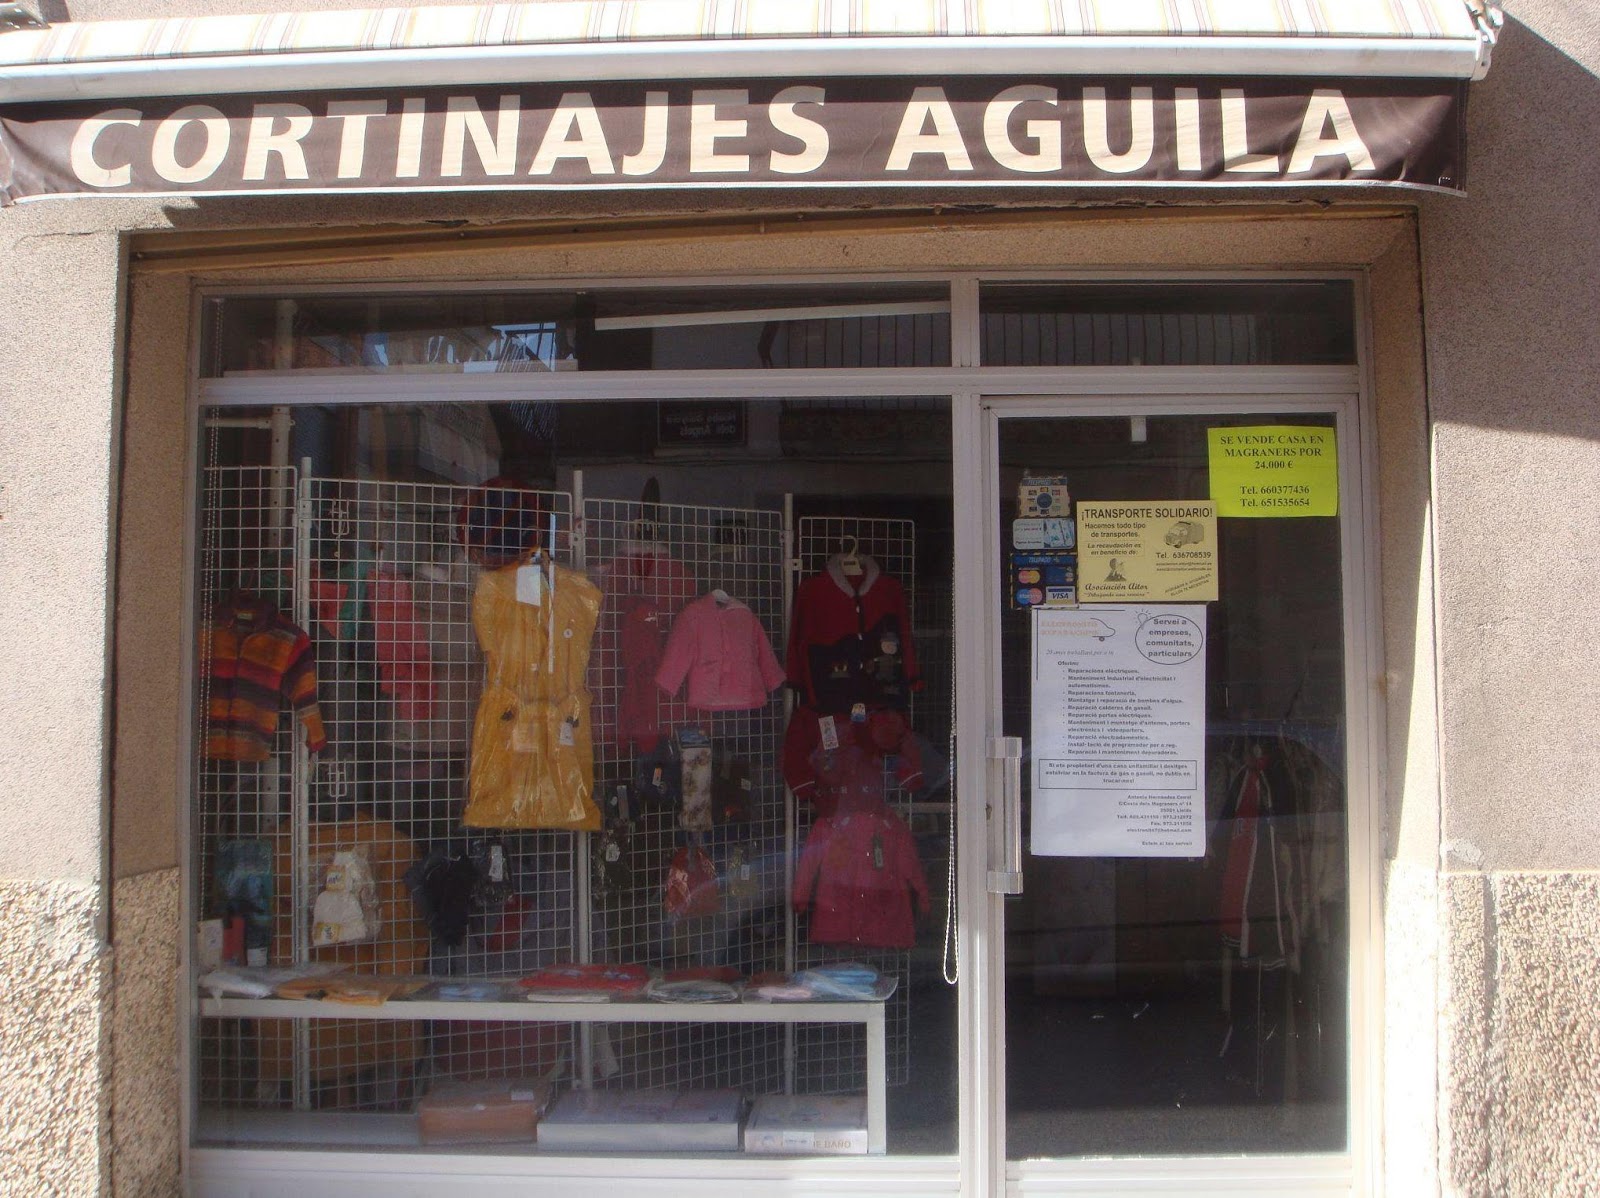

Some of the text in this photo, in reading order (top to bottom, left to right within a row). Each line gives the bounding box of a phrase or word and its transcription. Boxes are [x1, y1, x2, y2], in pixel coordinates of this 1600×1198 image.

[70, 84, 1375, 187] CORTINAJES AGUILA
[1220, 436, 1233, 445] SE
[1238, 436, 1275, 444] VENDE
[1278, 436, 1306, 444] CASA
[1225, 448, 1321, 457] MAGRANERS POR
[1255, 461, 1293, 469] 24.000 €
[1240, 486, 1310, 494] Tel. 660377436
[1081, 508, 1212, 520] ¡TRANSPORTE SOLIDARIO!
[1133, 522, 1146, 530] tipo
